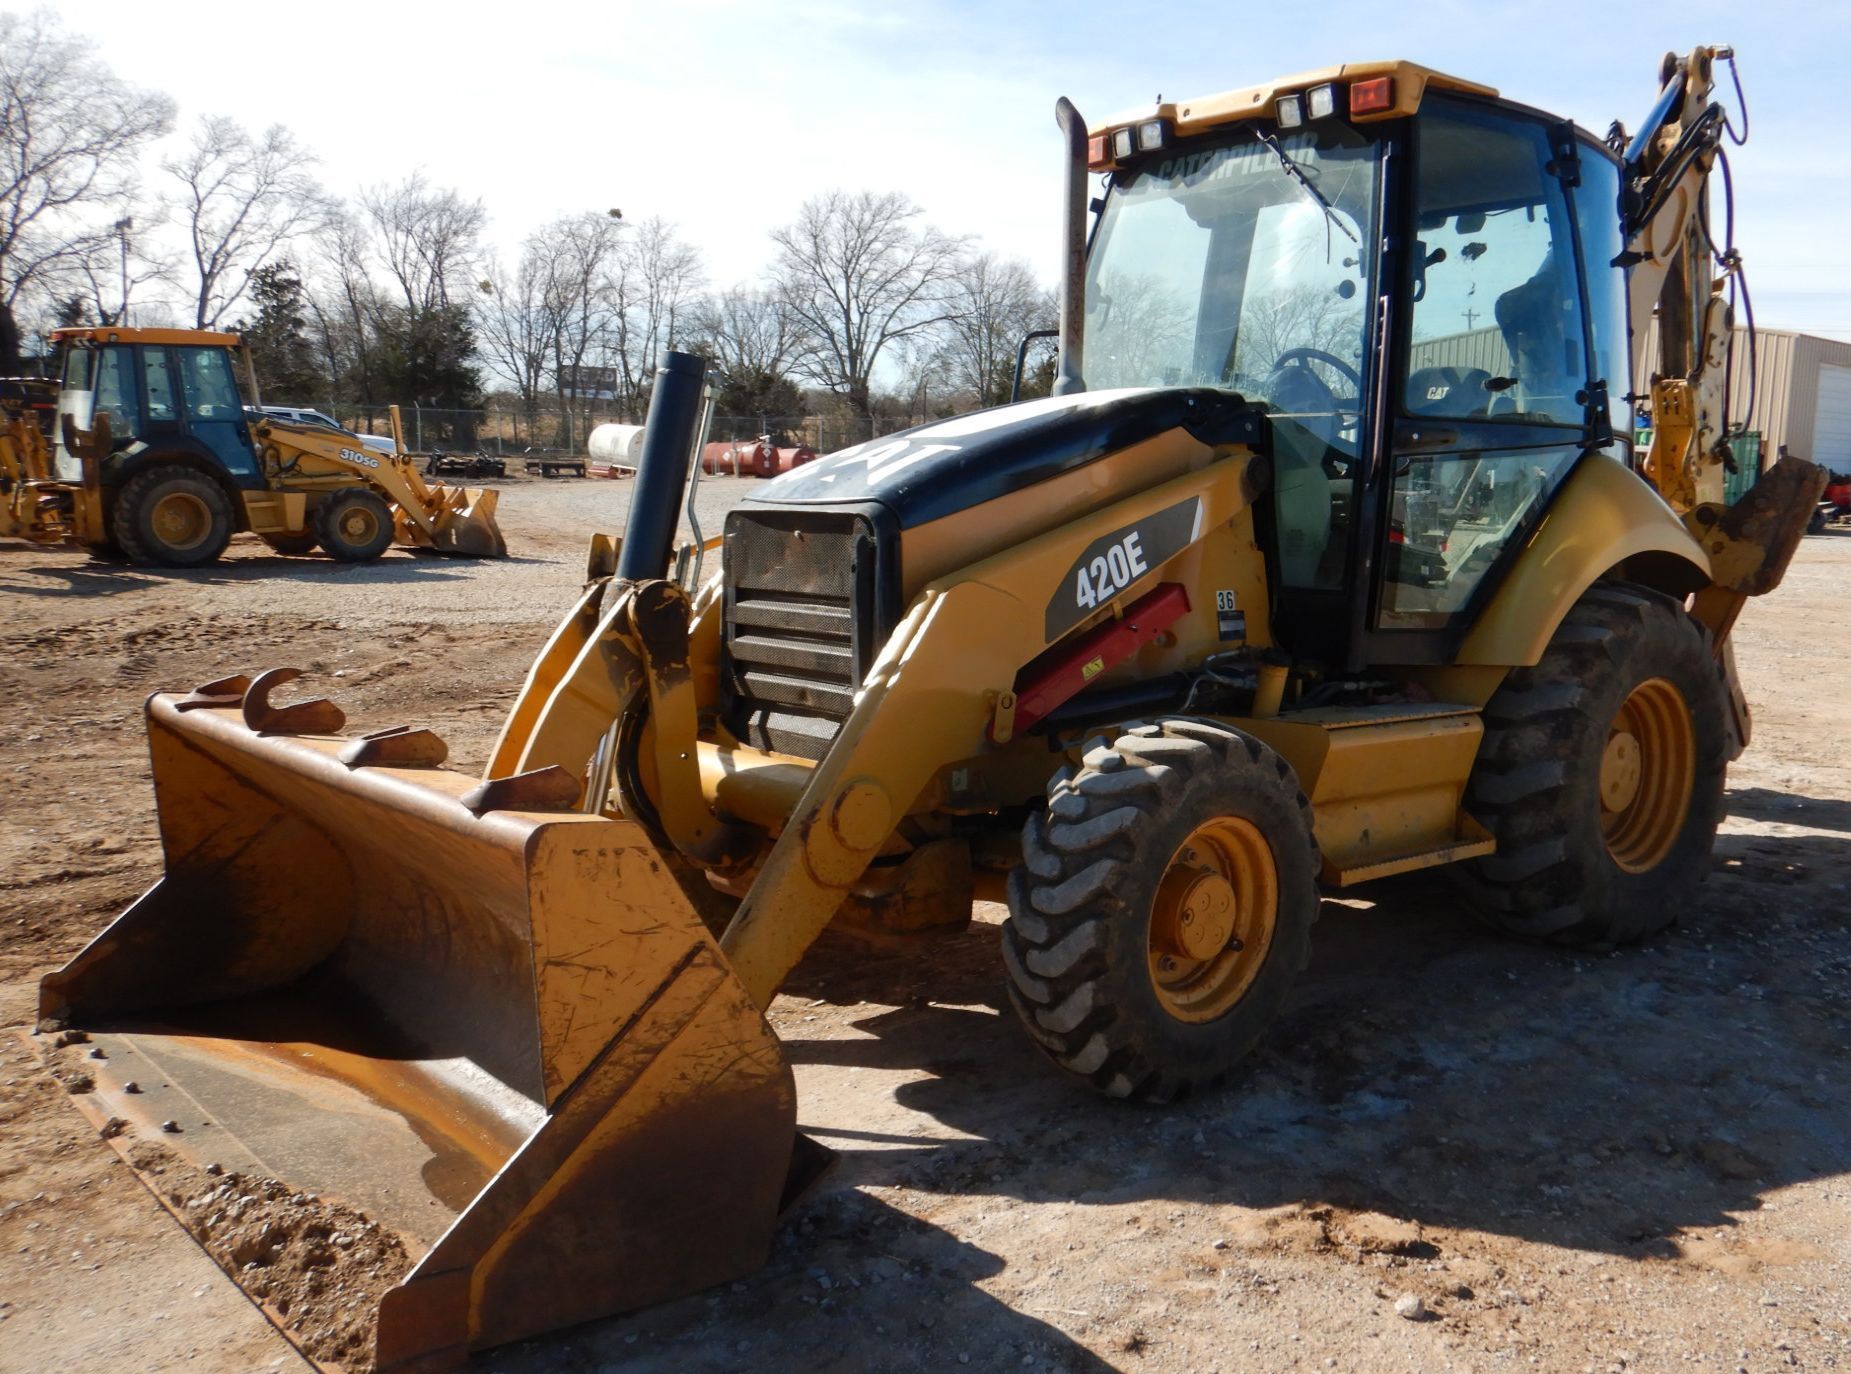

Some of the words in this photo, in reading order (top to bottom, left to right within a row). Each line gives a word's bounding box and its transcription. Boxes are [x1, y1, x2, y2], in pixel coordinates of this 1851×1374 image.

[1427, 387, 1450, 400] CAT
[339, 447, 380, 468] 310SG
[1076, 531, 1147, 608] 420E
[1218, 592, 1233, 609] 36
